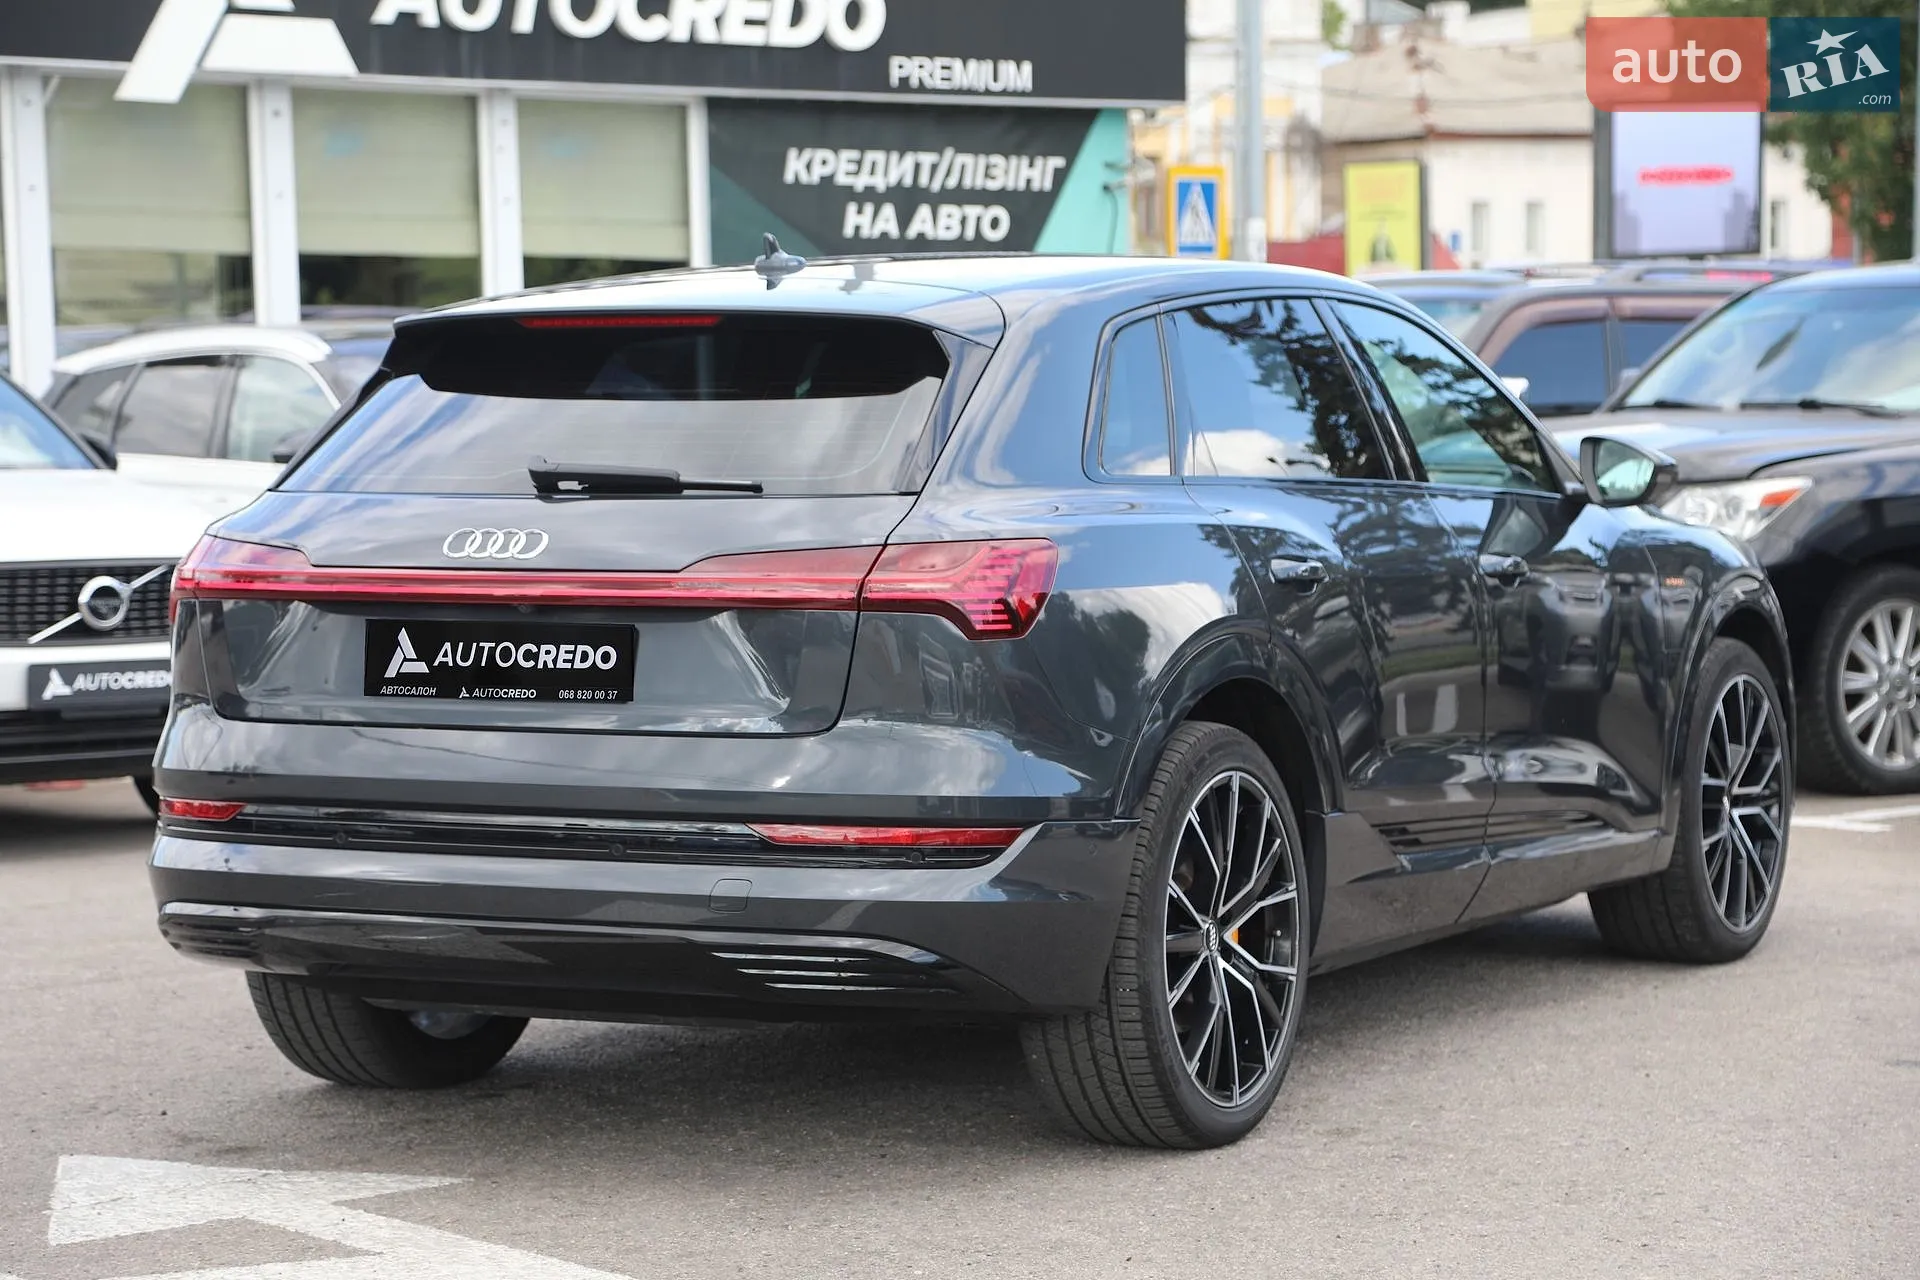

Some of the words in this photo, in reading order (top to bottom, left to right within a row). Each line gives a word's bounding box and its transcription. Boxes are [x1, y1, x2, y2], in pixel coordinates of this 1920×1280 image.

[888, 54, 1033, 93] PREMIUM
[783, 147, 1067, 194] КРЕДИТ/ЛІЗІНГ
[842, 201, 900, 240] НА
[905, 203, 1011, 242] АВТО
[433, 641, 618, 670] AUTOCREDO
[380, 685, 437, 696] АВТОСАЛОН
[472, 688, 537, 699] AUTOCREDO
[558, 689, 575, 699] 068
[576, 690, 593, 700] 820
[594, 690, 606, 700] 00
[607, 690, 618, 700] 37
